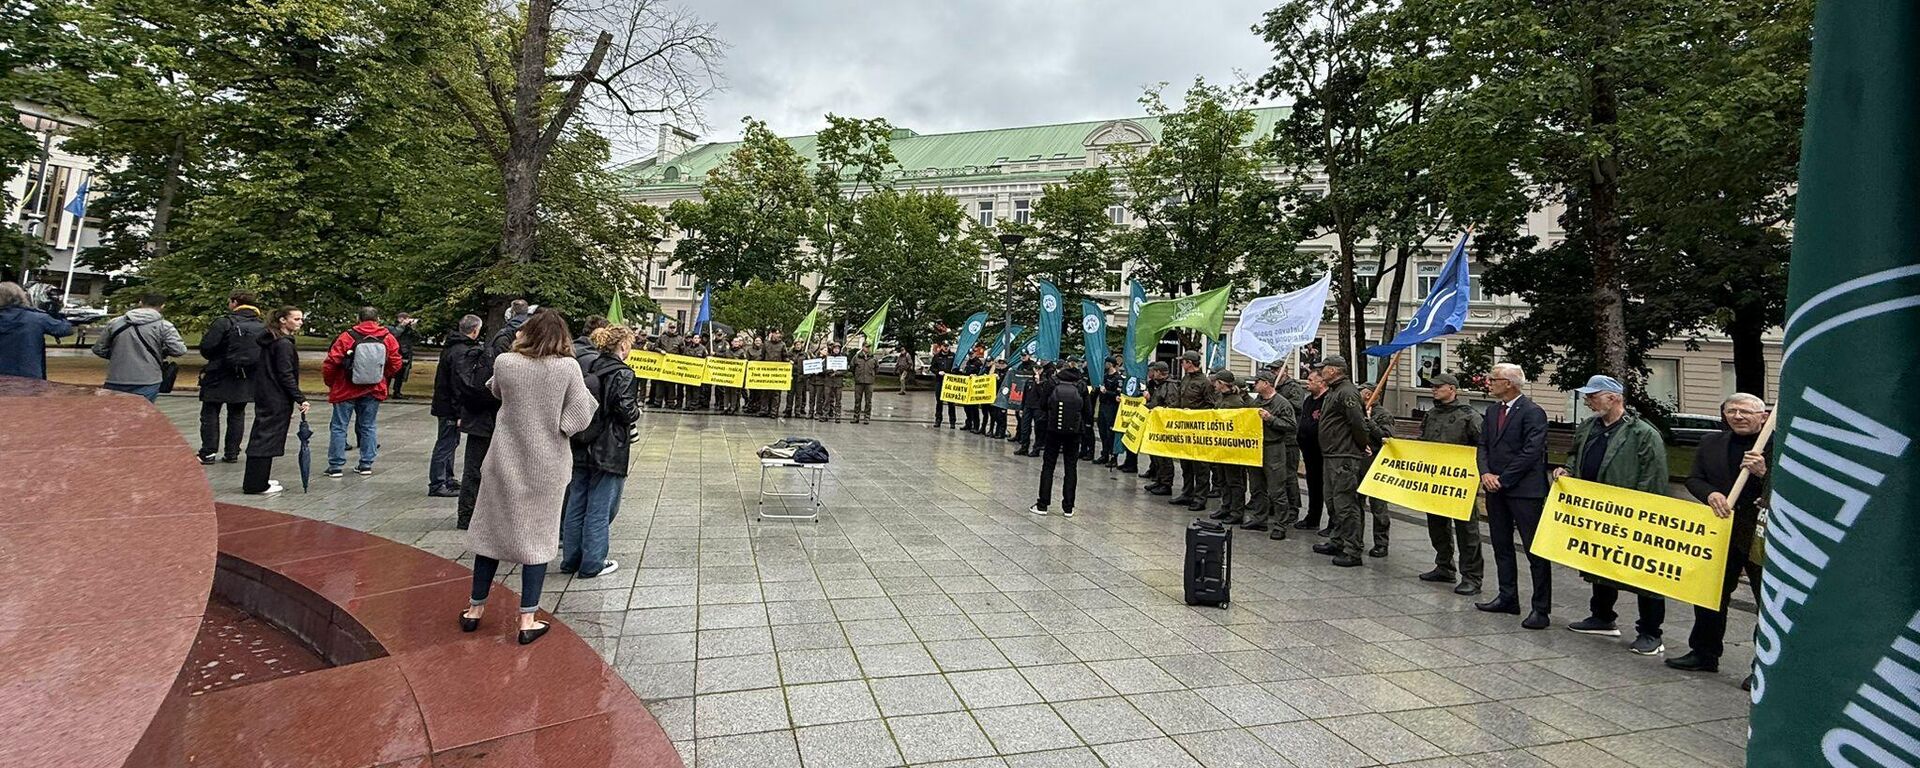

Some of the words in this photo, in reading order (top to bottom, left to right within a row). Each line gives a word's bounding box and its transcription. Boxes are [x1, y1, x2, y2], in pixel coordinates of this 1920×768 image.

[1174, 420, 1206, 430] SUTINKATE
[1206, 419, 1225, 431] LOŠTI
[1226, 419, 1234, 432] IŠ
[1148, 432, 1184, 444] VISUOMENĖS
[1185, 436, 1192, 444] IR
[1192, 433, 1213, 446] ŠALIES
[1213, 438, 1259, 449] SAUGUMO?!
[1381, 457, 1438, 477] PAREIGŪNŲ
[1373, 471, 1429, 493] GERIAUSIA
[1431, 483, 1468, 499] DIETA!
[1557, 492, 1635, 519] PAREIGŪNO
[1637, 510, 1706, 536] PENSIJA
[1554, 510, 1629, 539] VALSTYBĖS
[1632, 530, 1713, 560] DAROMOS
[1566, 537, 1683, 582] PATYČIOS!!!
